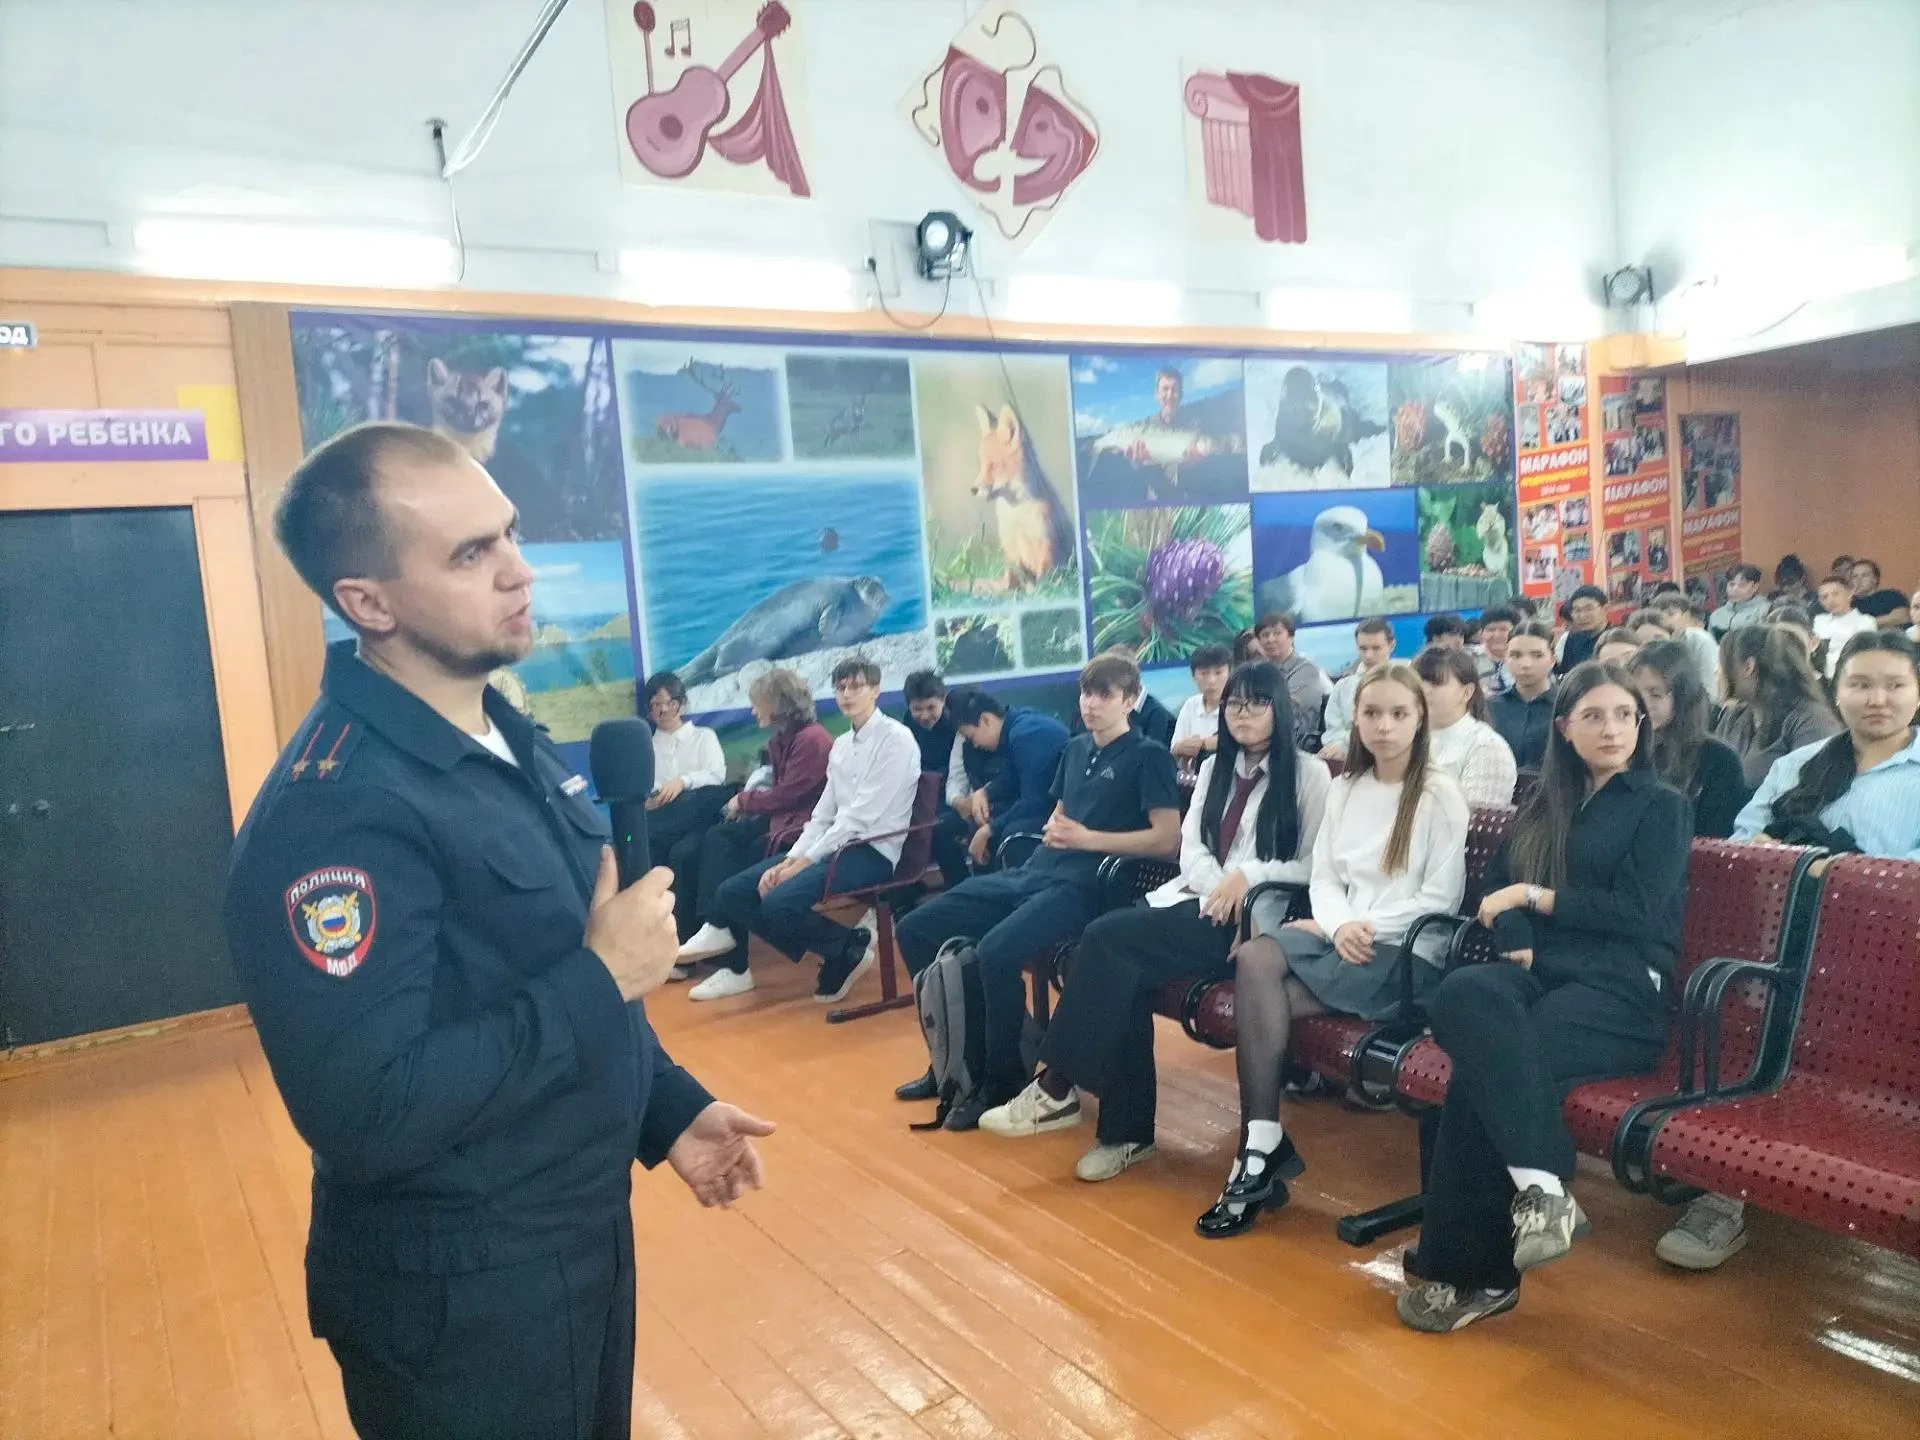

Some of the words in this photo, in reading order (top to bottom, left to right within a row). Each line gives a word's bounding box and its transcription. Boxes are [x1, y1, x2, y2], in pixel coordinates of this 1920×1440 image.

[48, 420, 192, 446] РЕБЕНКА
[1520, 447, 1588, 475] МАРАФОН
[1604, 475, 1668, 503] МАРАФОН
[1683, 509, 1739, 537] МАРАФОН
[291, 870, 366, 904] ПОЛИЦИЯ
[326, 953, 358, 977] МВД
